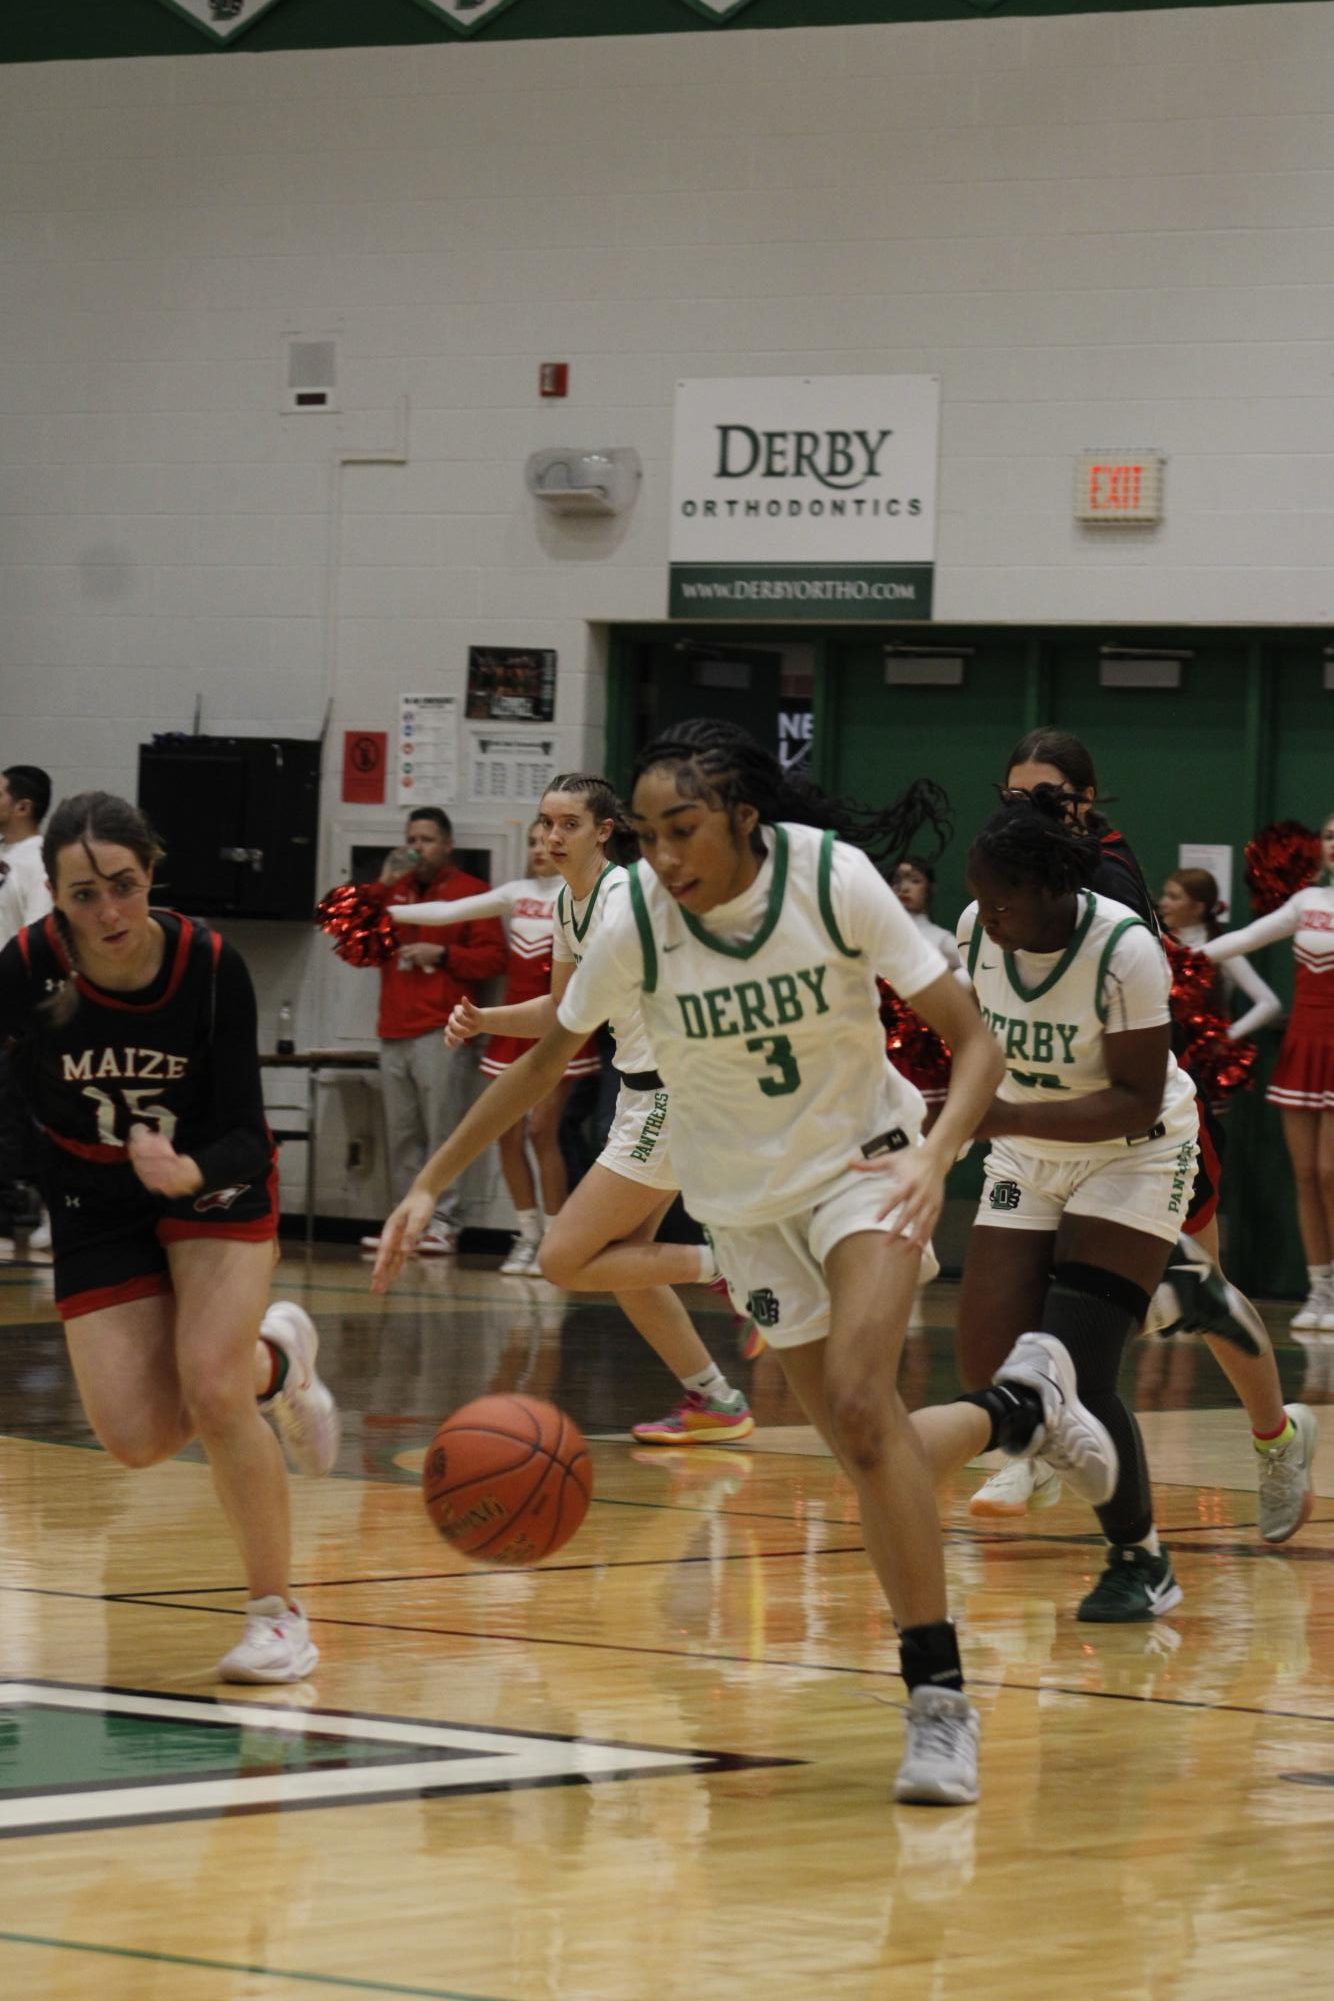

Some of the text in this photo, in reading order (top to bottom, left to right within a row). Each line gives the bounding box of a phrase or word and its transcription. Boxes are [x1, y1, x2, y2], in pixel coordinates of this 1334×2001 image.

[714, 425, 893, 490] DERBY
[1090, 464, 1142, 509] EXIT
[681, 499, 922, 517] ORTHODONTICS
[675, 965, 830, 1039] DERBY
[62, 1047, 188, 1080] MAIZE
[746, 1034, 801, 1097] 3
[630, 1092, 669, 1163] PANTHERS
